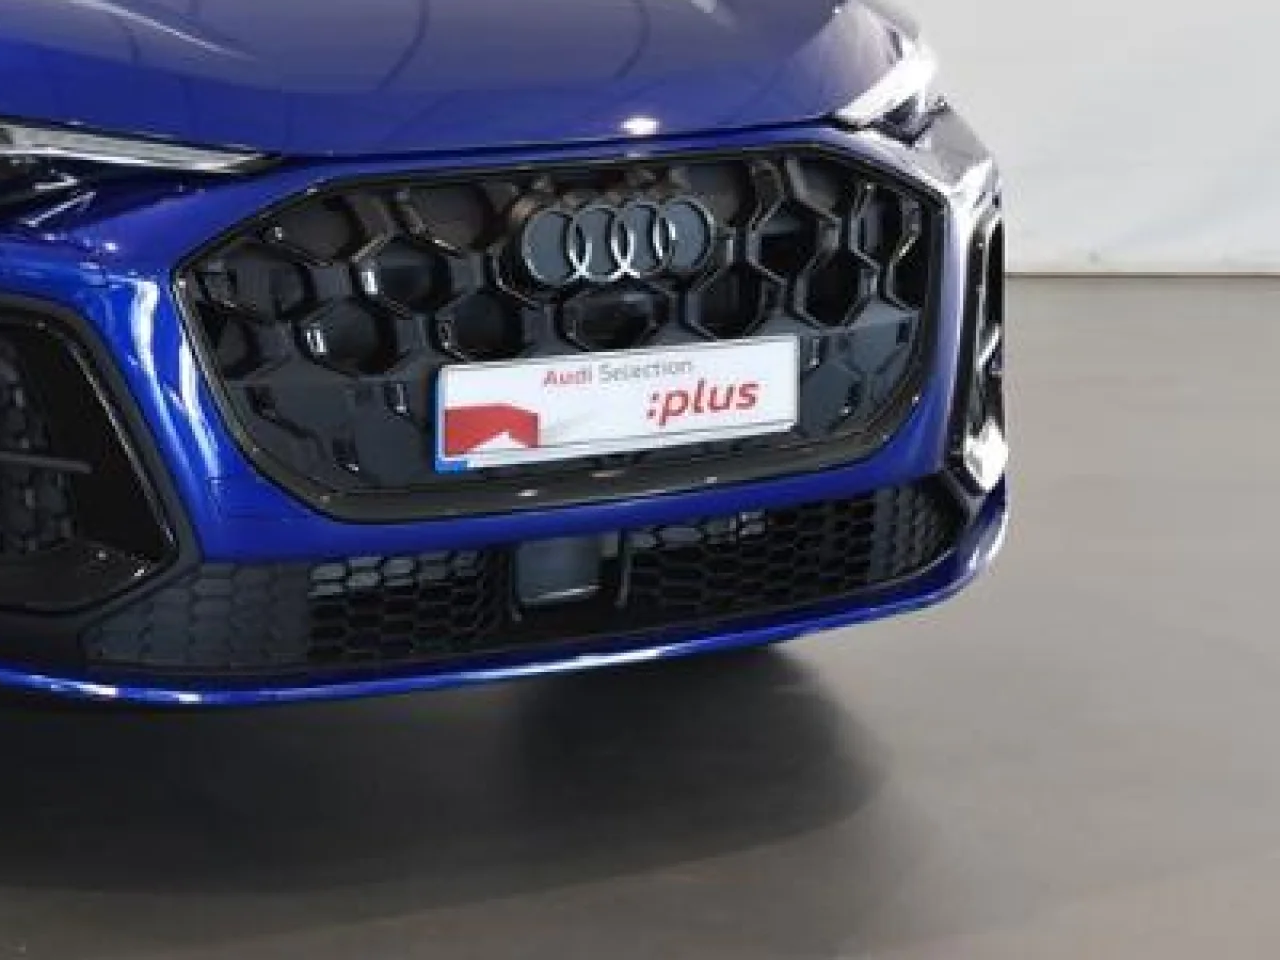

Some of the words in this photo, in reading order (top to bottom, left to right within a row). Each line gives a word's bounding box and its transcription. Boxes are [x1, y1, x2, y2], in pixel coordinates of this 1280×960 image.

[543, 369, 593, 386] Audi
[598, 361, 692, 384] Selection
[646, 376, 761, 426] :plus
